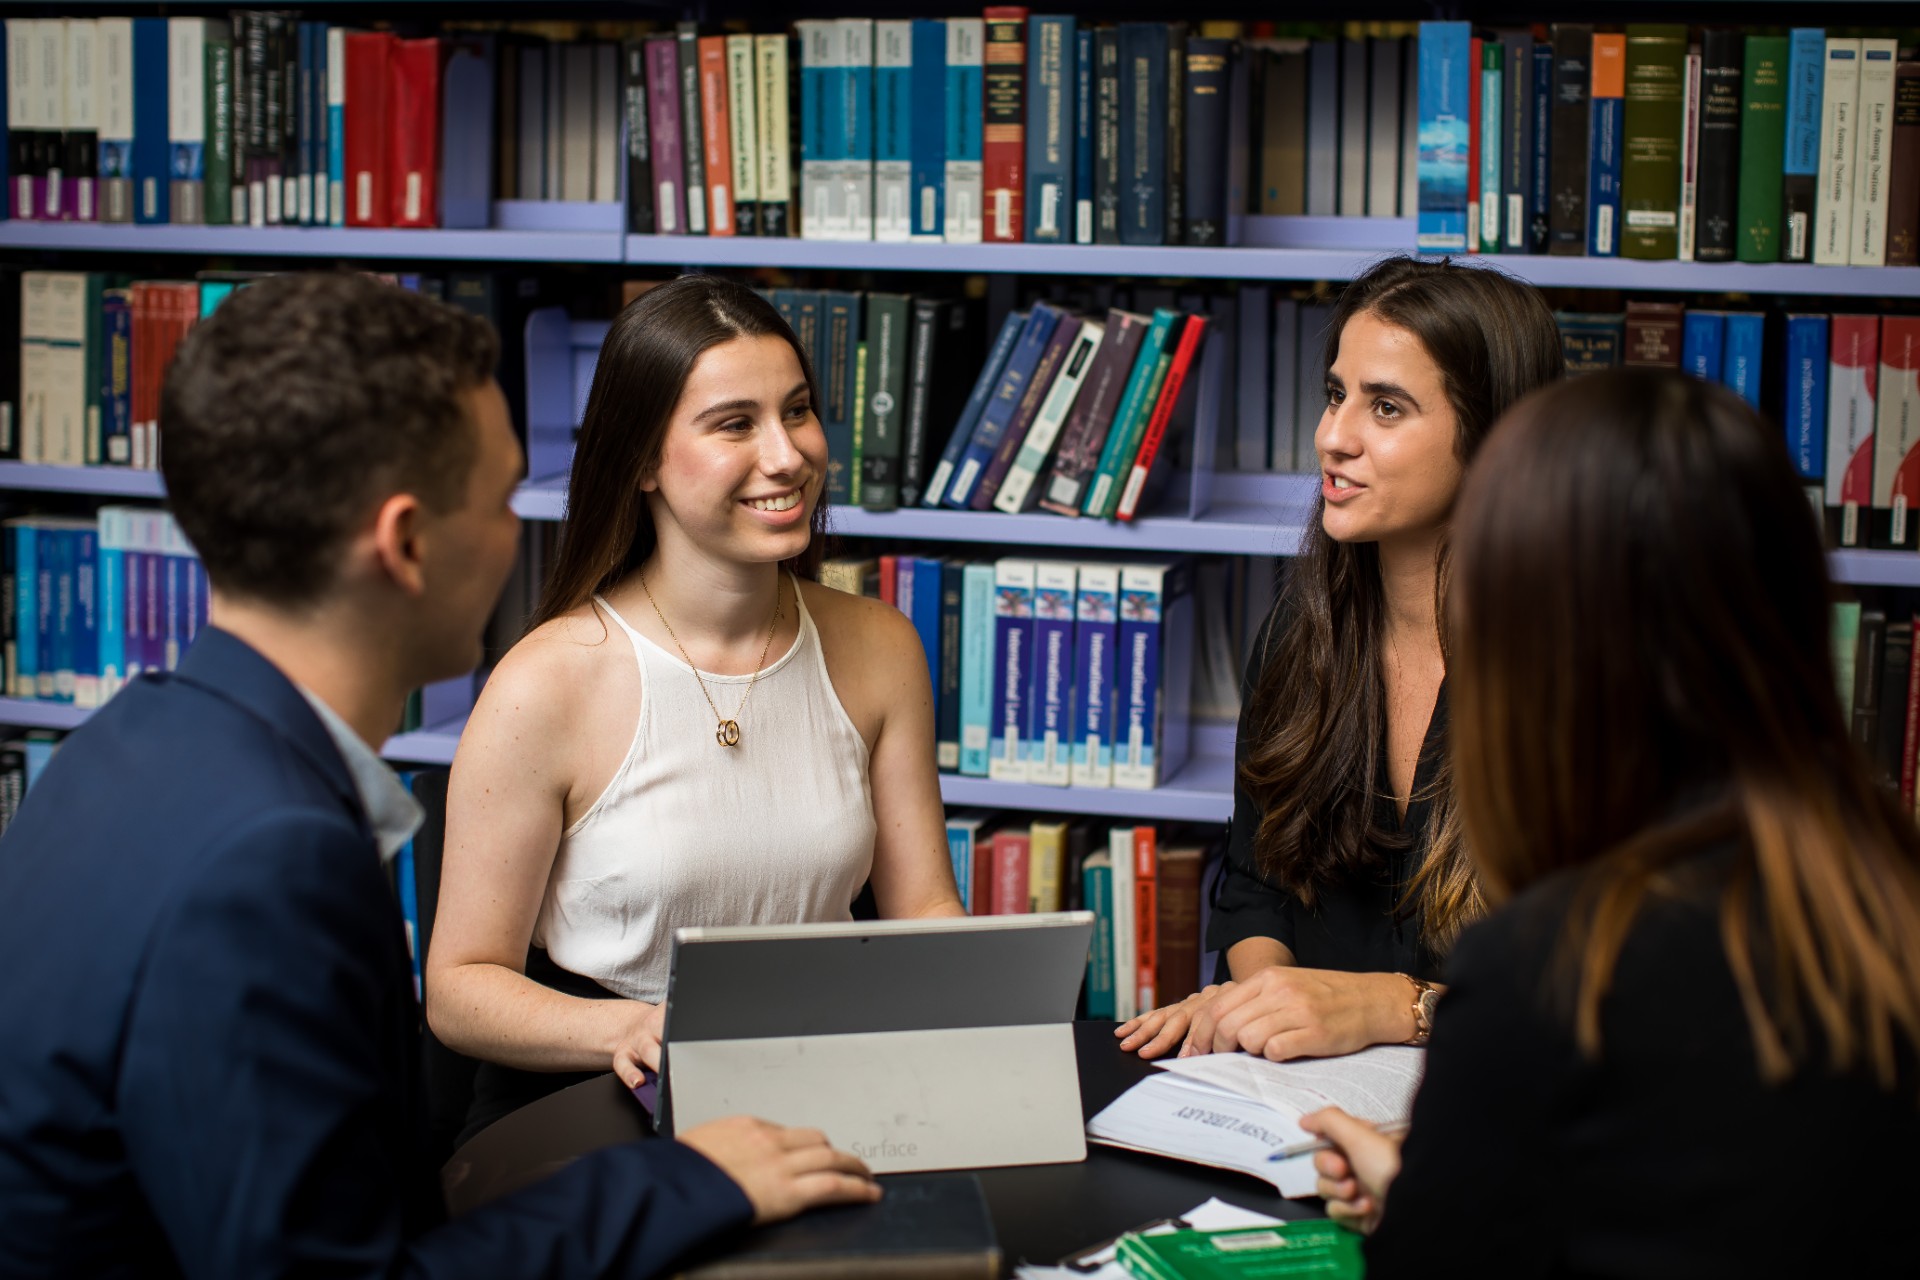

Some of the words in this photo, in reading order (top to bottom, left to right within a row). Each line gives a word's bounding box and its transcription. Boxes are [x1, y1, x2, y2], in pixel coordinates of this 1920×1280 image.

[1838, 102, 1849, 122] Law
[1874, 103, 1885, 123] Law
[1006, 629, 1022, 700] International
[1046, 631, 1062, 703] International
[1088, 633, 1105, 706] International
[1131, 632, 1148, 705] International
[1005, 702, 1019, 725] Law
[1045, 705, 1059, 728] Law
[1087, 708, 1101, 731] Law
[1171, 1106, 1240, 1130] LIBRARY
[1232, 1121, 1284, 1147] UNSW
[851, 1138, 918, 1159] Surface
